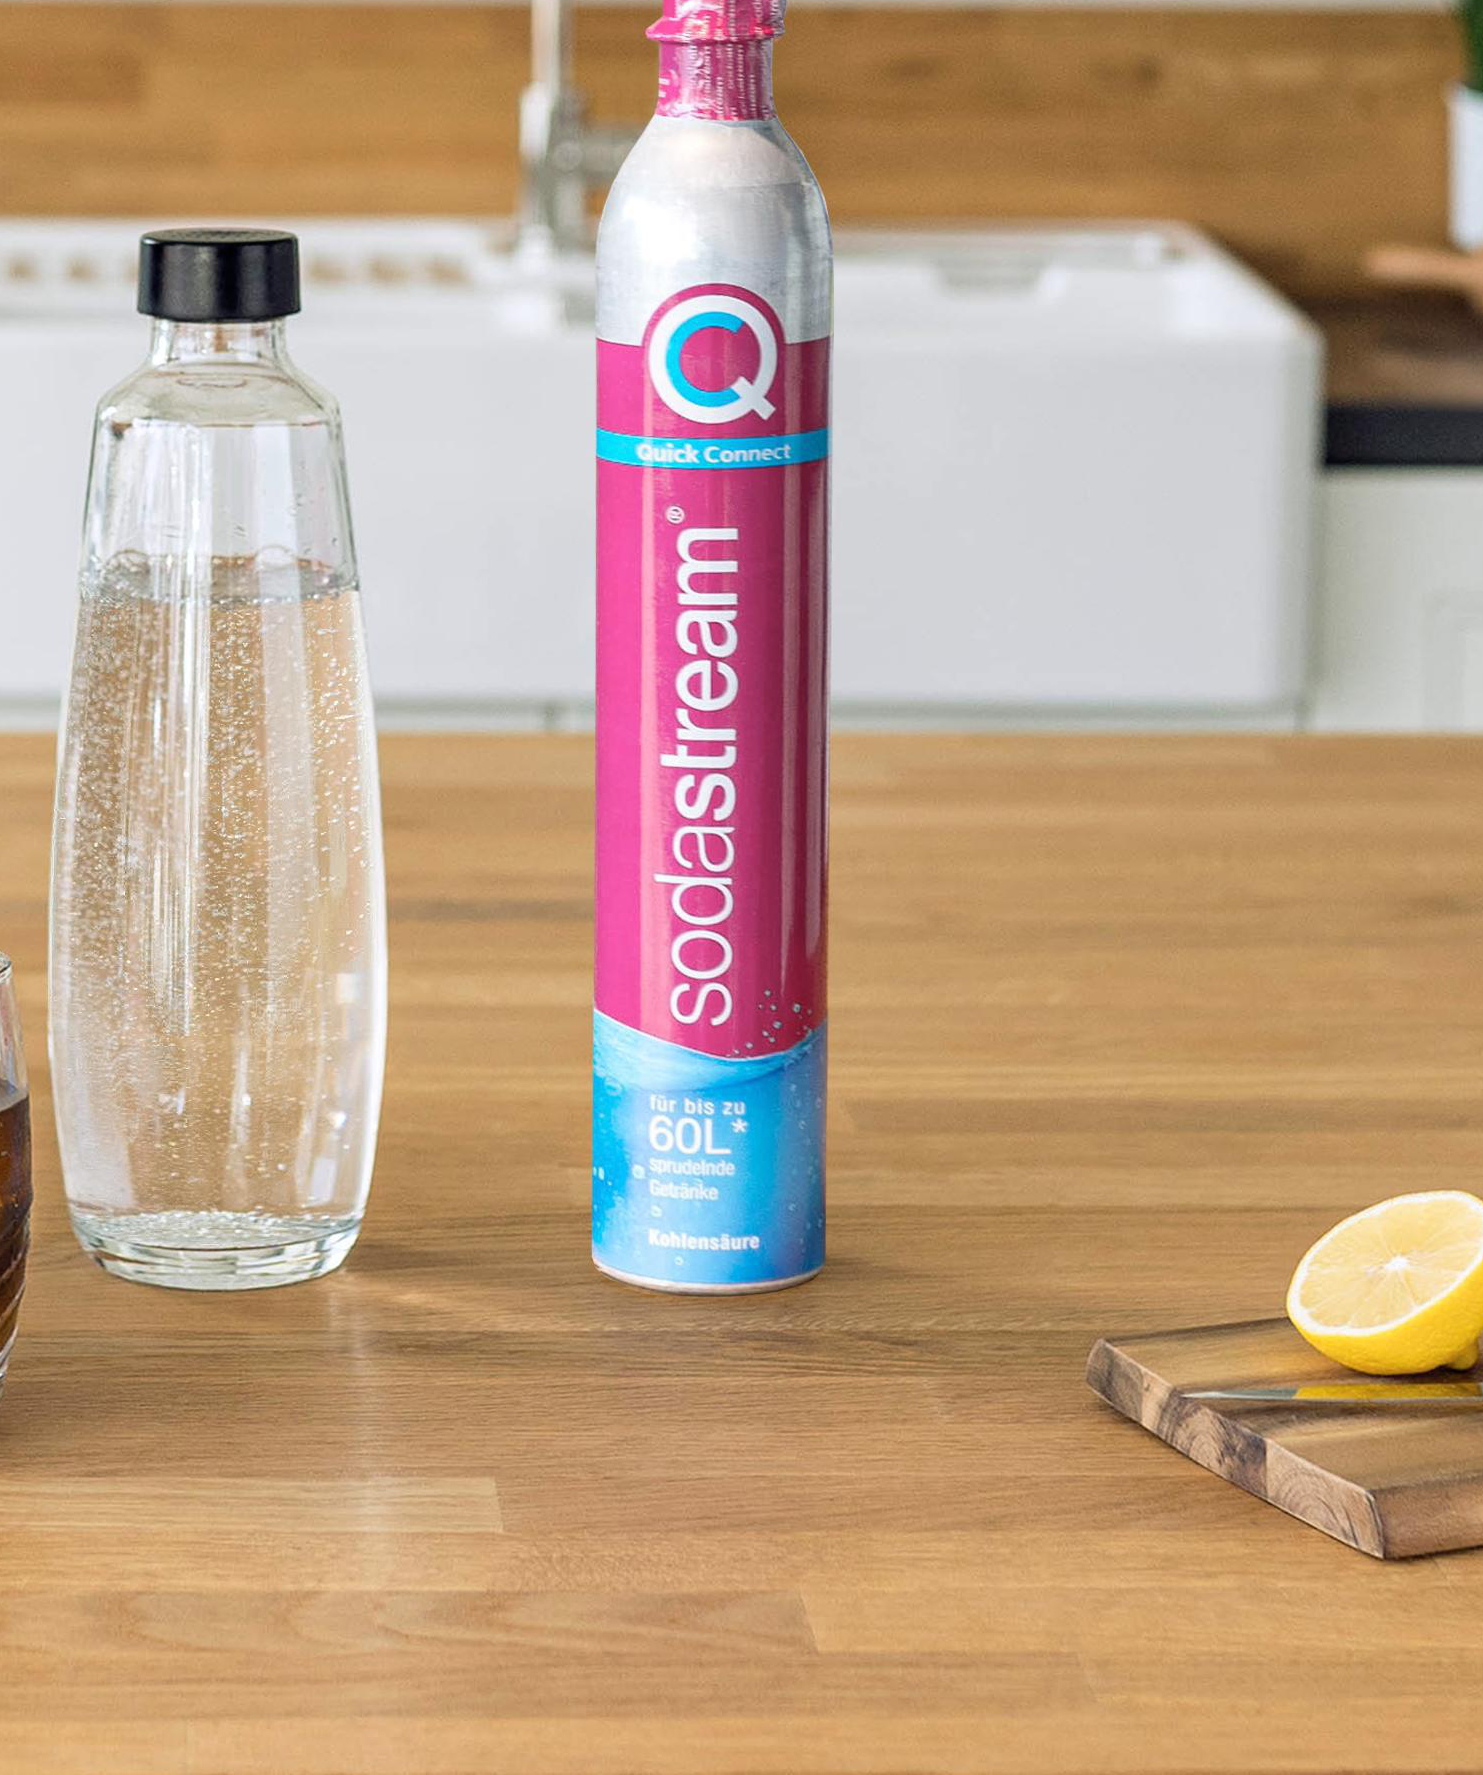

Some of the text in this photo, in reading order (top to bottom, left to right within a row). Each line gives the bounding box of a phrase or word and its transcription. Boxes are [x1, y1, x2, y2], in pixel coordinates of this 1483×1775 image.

[636, 443, 791, 465] Quick Connect
[649, 1093, 747, 1115] für bis zu
[649, 1157, 736, 1177] sprudelnde
[649, 1178, 719, 1201] Getränke
[648, 1228, 761, 1251] Kohlensäure
